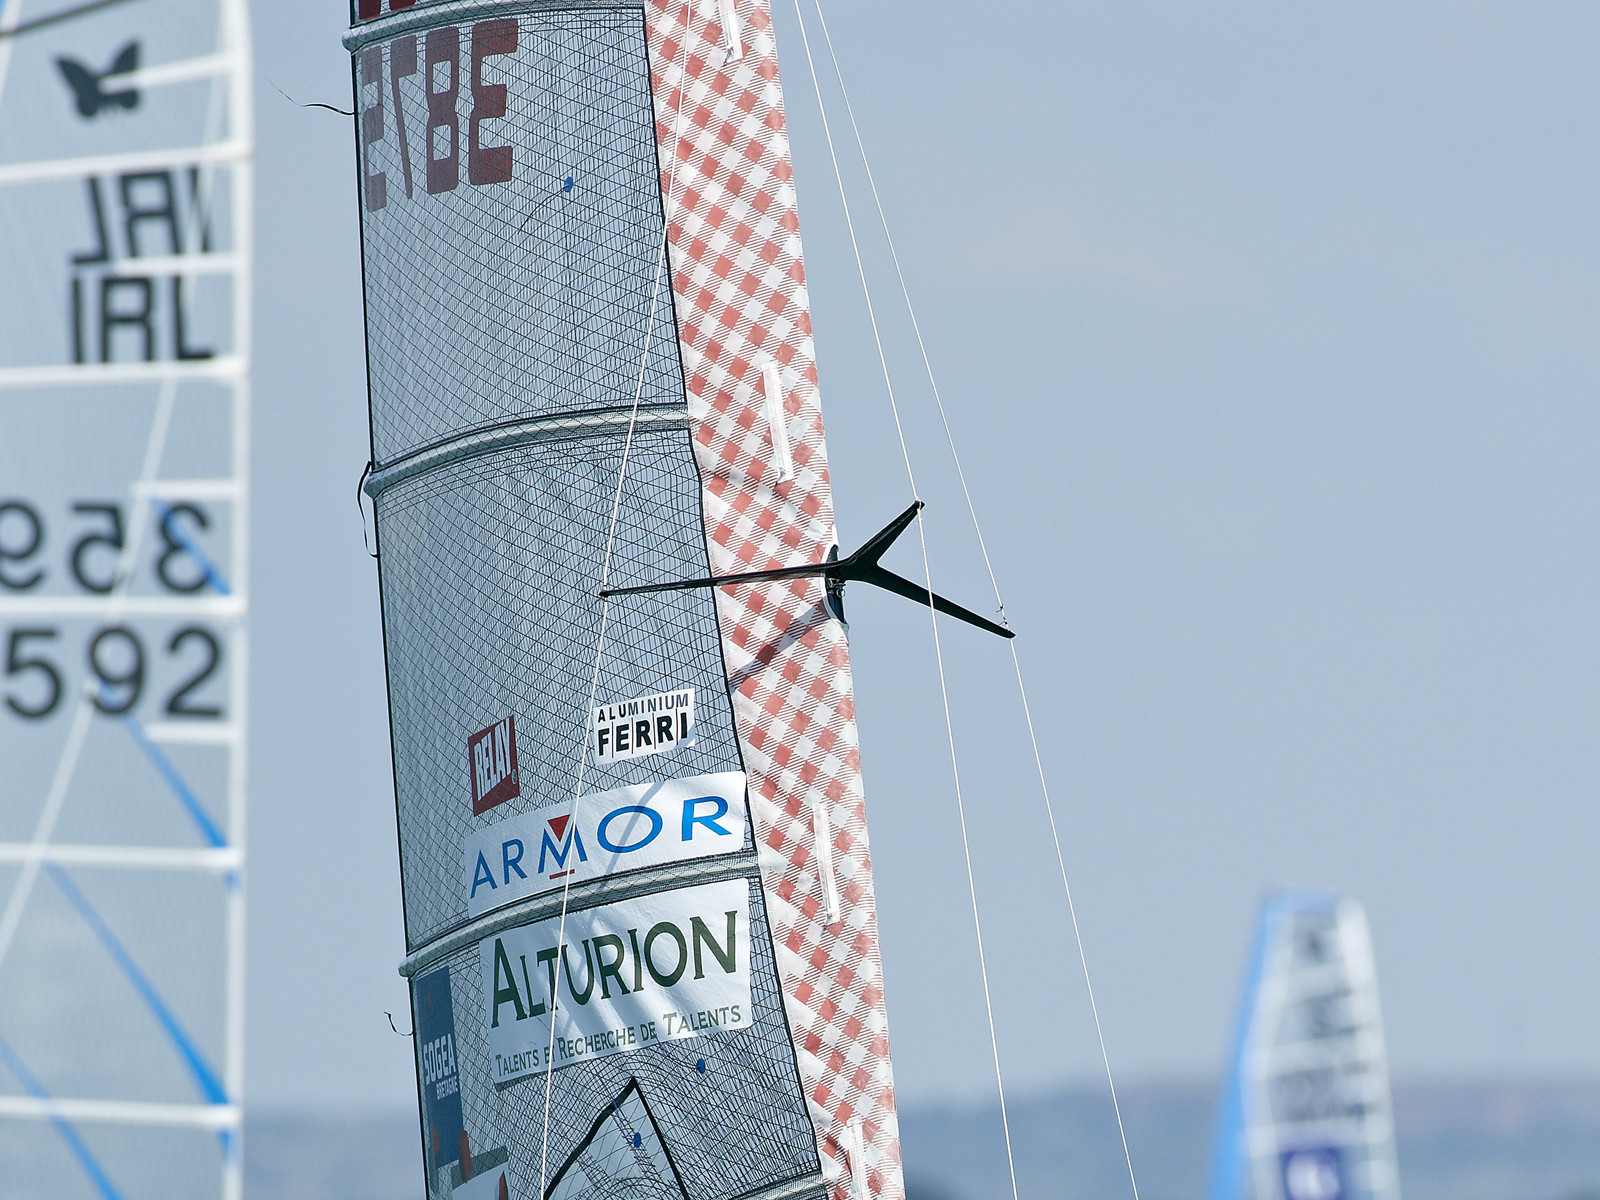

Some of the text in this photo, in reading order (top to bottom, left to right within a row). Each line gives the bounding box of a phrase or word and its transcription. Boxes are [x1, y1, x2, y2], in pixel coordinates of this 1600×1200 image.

[70, 271, 215, 365] IRL
[598, 693, 689, 723] ALUMINIUM
[598, 712, 688, 756] FERRI
[474, 717, 511, 801] RELAY
[469, 795, 733, 899] ARMOR
[490, 910, 738, 1029] ALTURION
[423, 1033, 456, 1085] SOGEA
